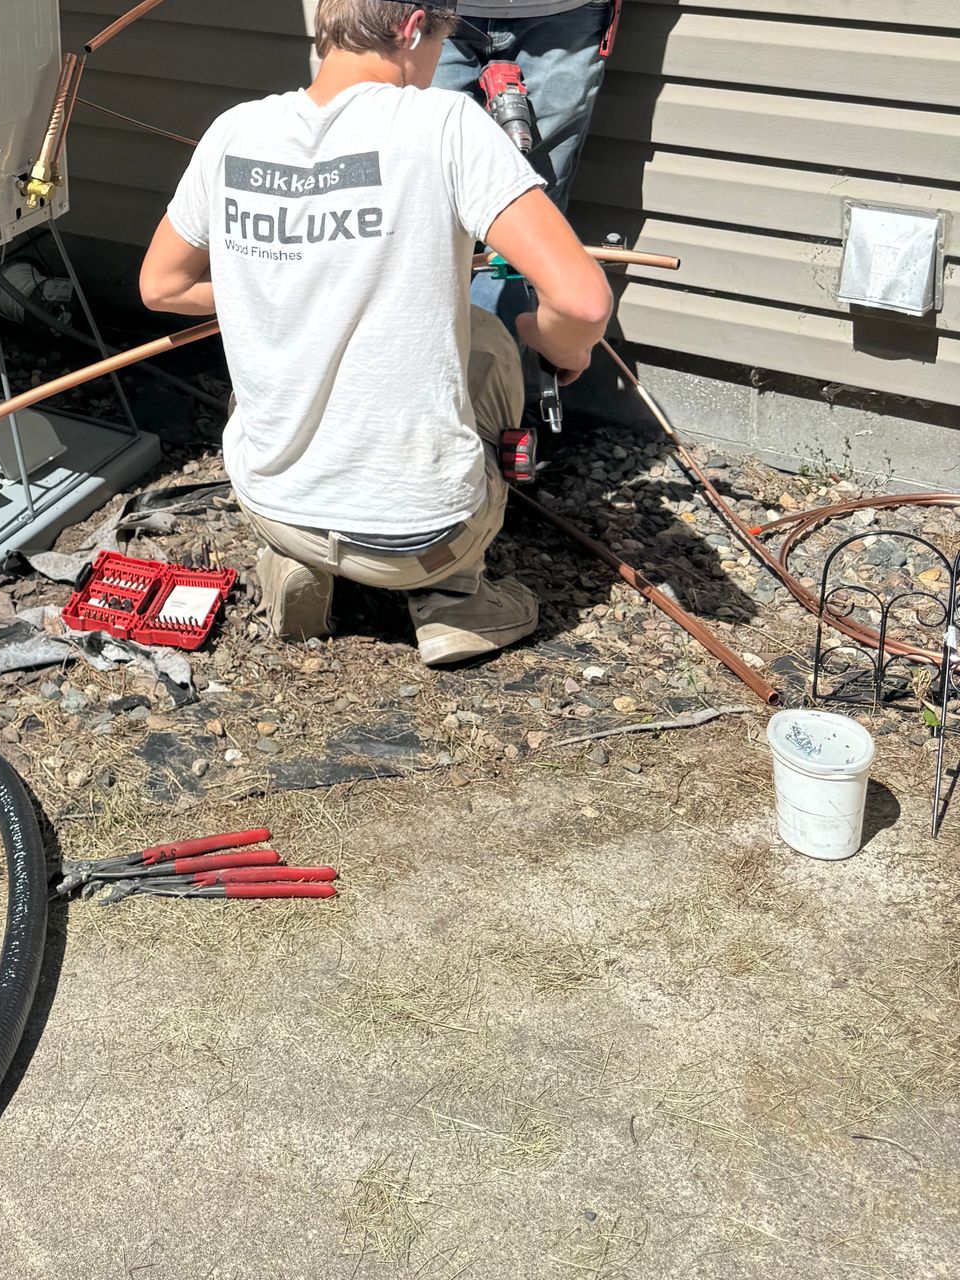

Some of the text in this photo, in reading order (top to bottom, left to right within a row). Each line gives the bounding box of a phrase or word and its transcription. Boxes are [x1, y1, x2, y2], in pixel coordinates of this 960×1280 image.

[249, 167, 340, 192] Sikkens
[225, 197, 383, 244] ProLuxe
[251, 245, 302, 261] Finishes
